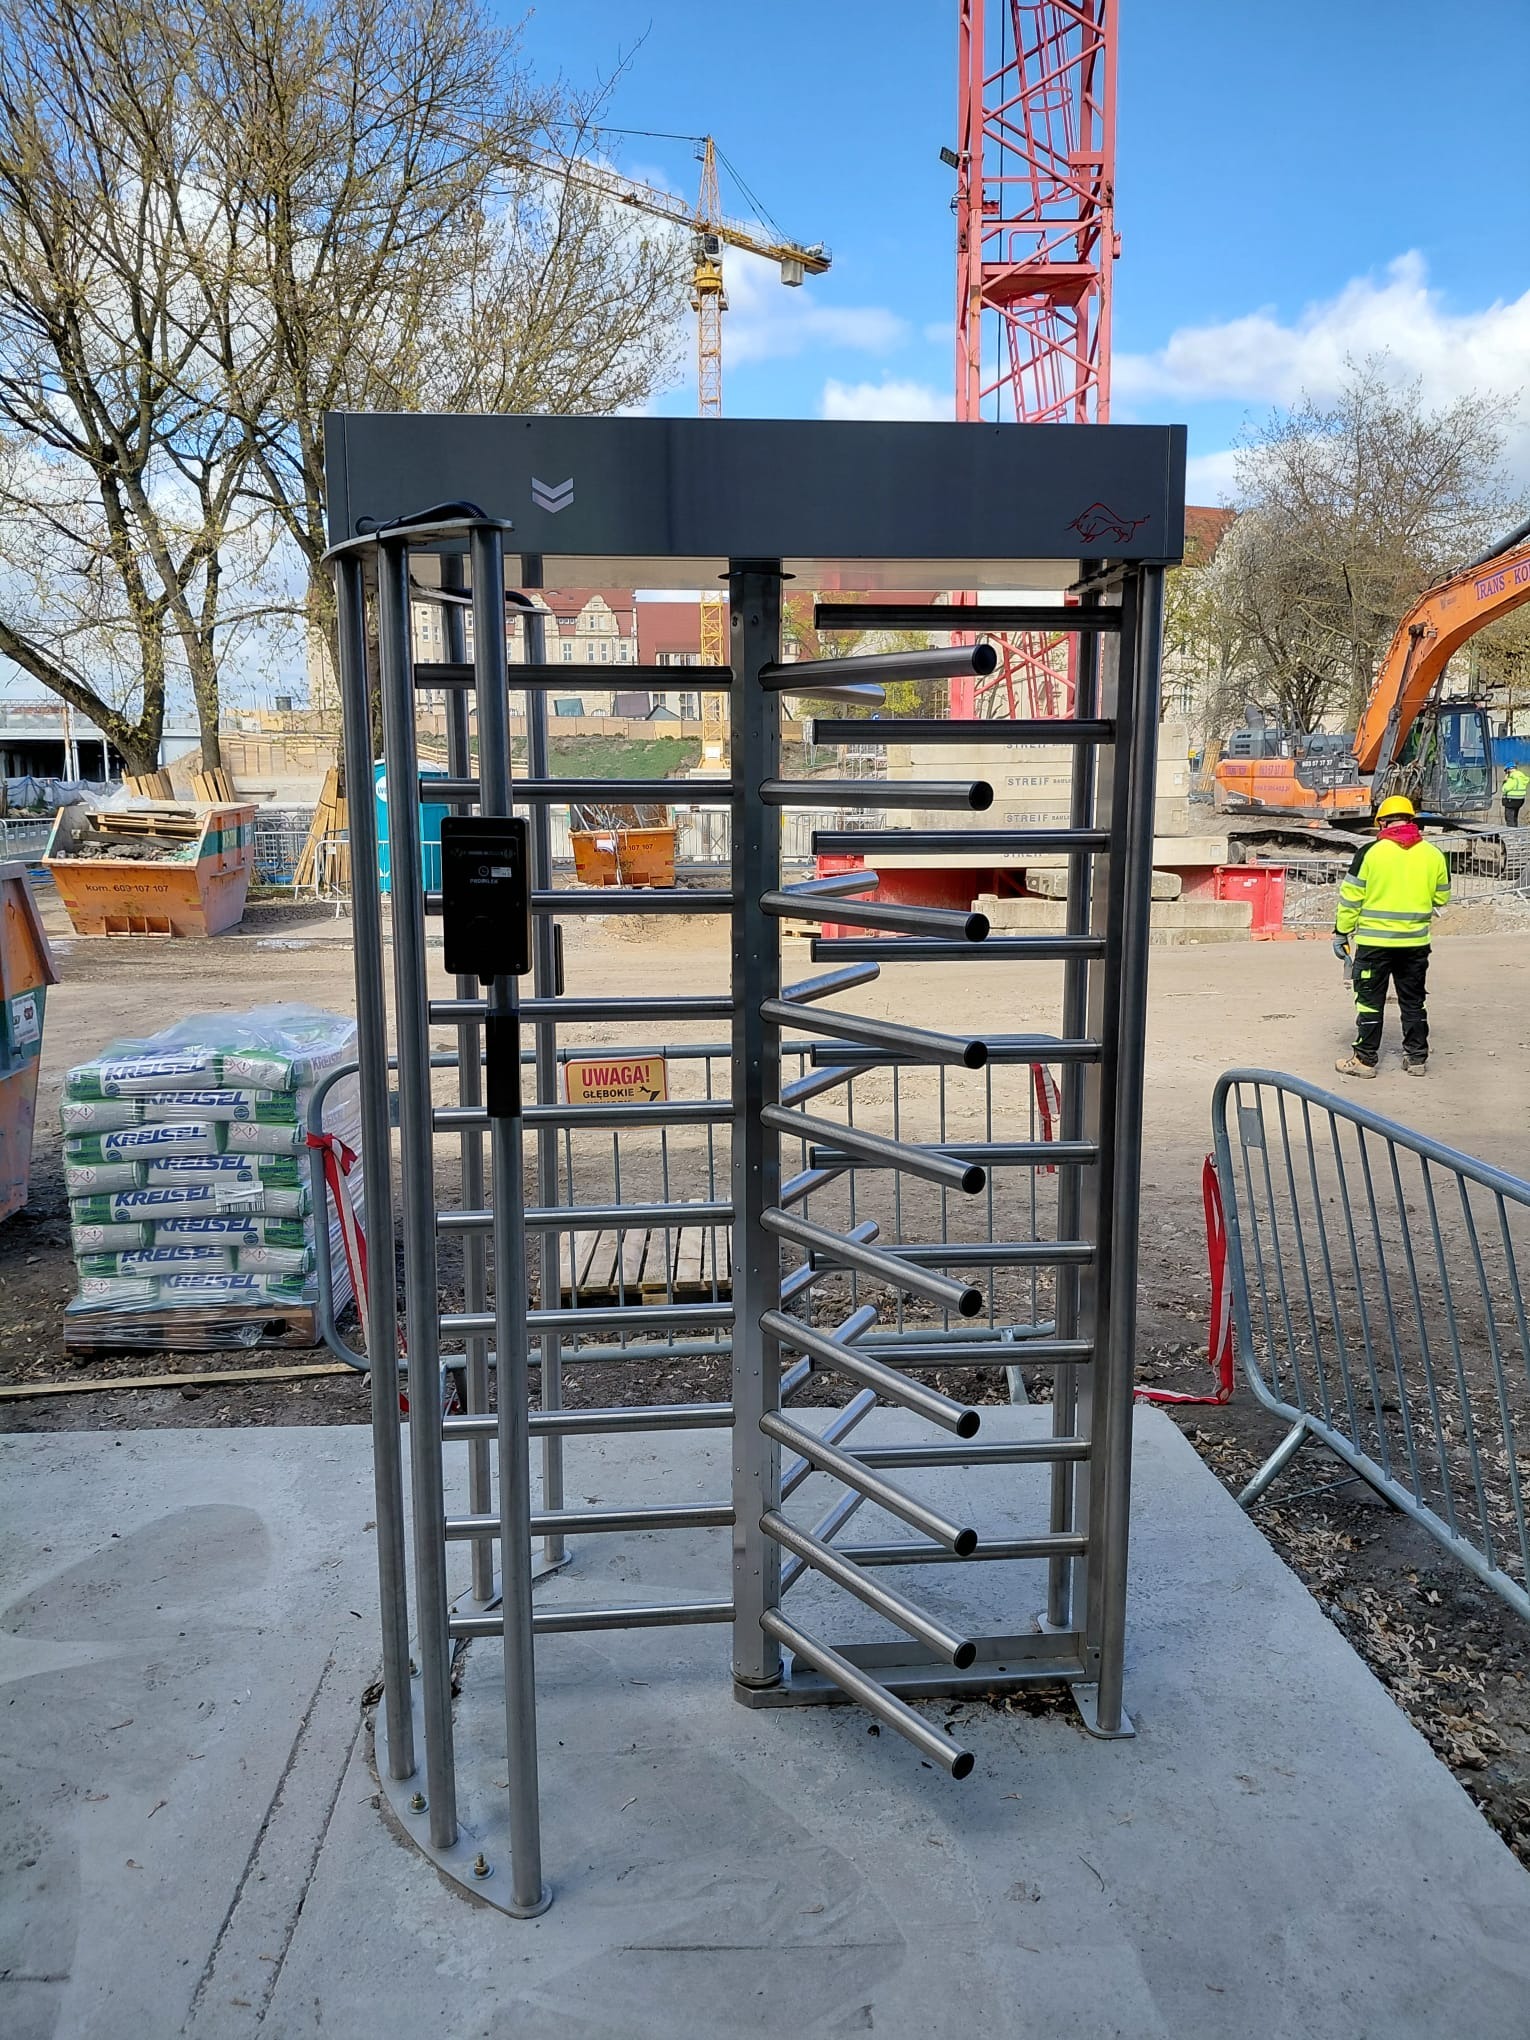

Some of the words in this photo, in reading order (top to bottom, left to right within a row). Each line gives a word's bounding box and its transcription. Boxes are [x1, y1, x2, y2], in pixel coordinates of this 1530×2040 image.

[1474, 574, 1505, 601] TRANS
[1007, 778, 1049, 786] STREIF
[1006, 814, 1048, 822] STREIF
[85, 884, 111, 892] kom.
[134, 884, 150, 892] 107
[152, 884, 169, 892] 107
[105, 1061, 206, 1082] KREISEL
[581, 1065, 650, 1087] UWAGA!
[582, 1088, 635, 1100] GŁĘBOKIE
[105, 1126, 207, 1149] KREISEL
[114, 1186, 215, 1207] KREISEL
